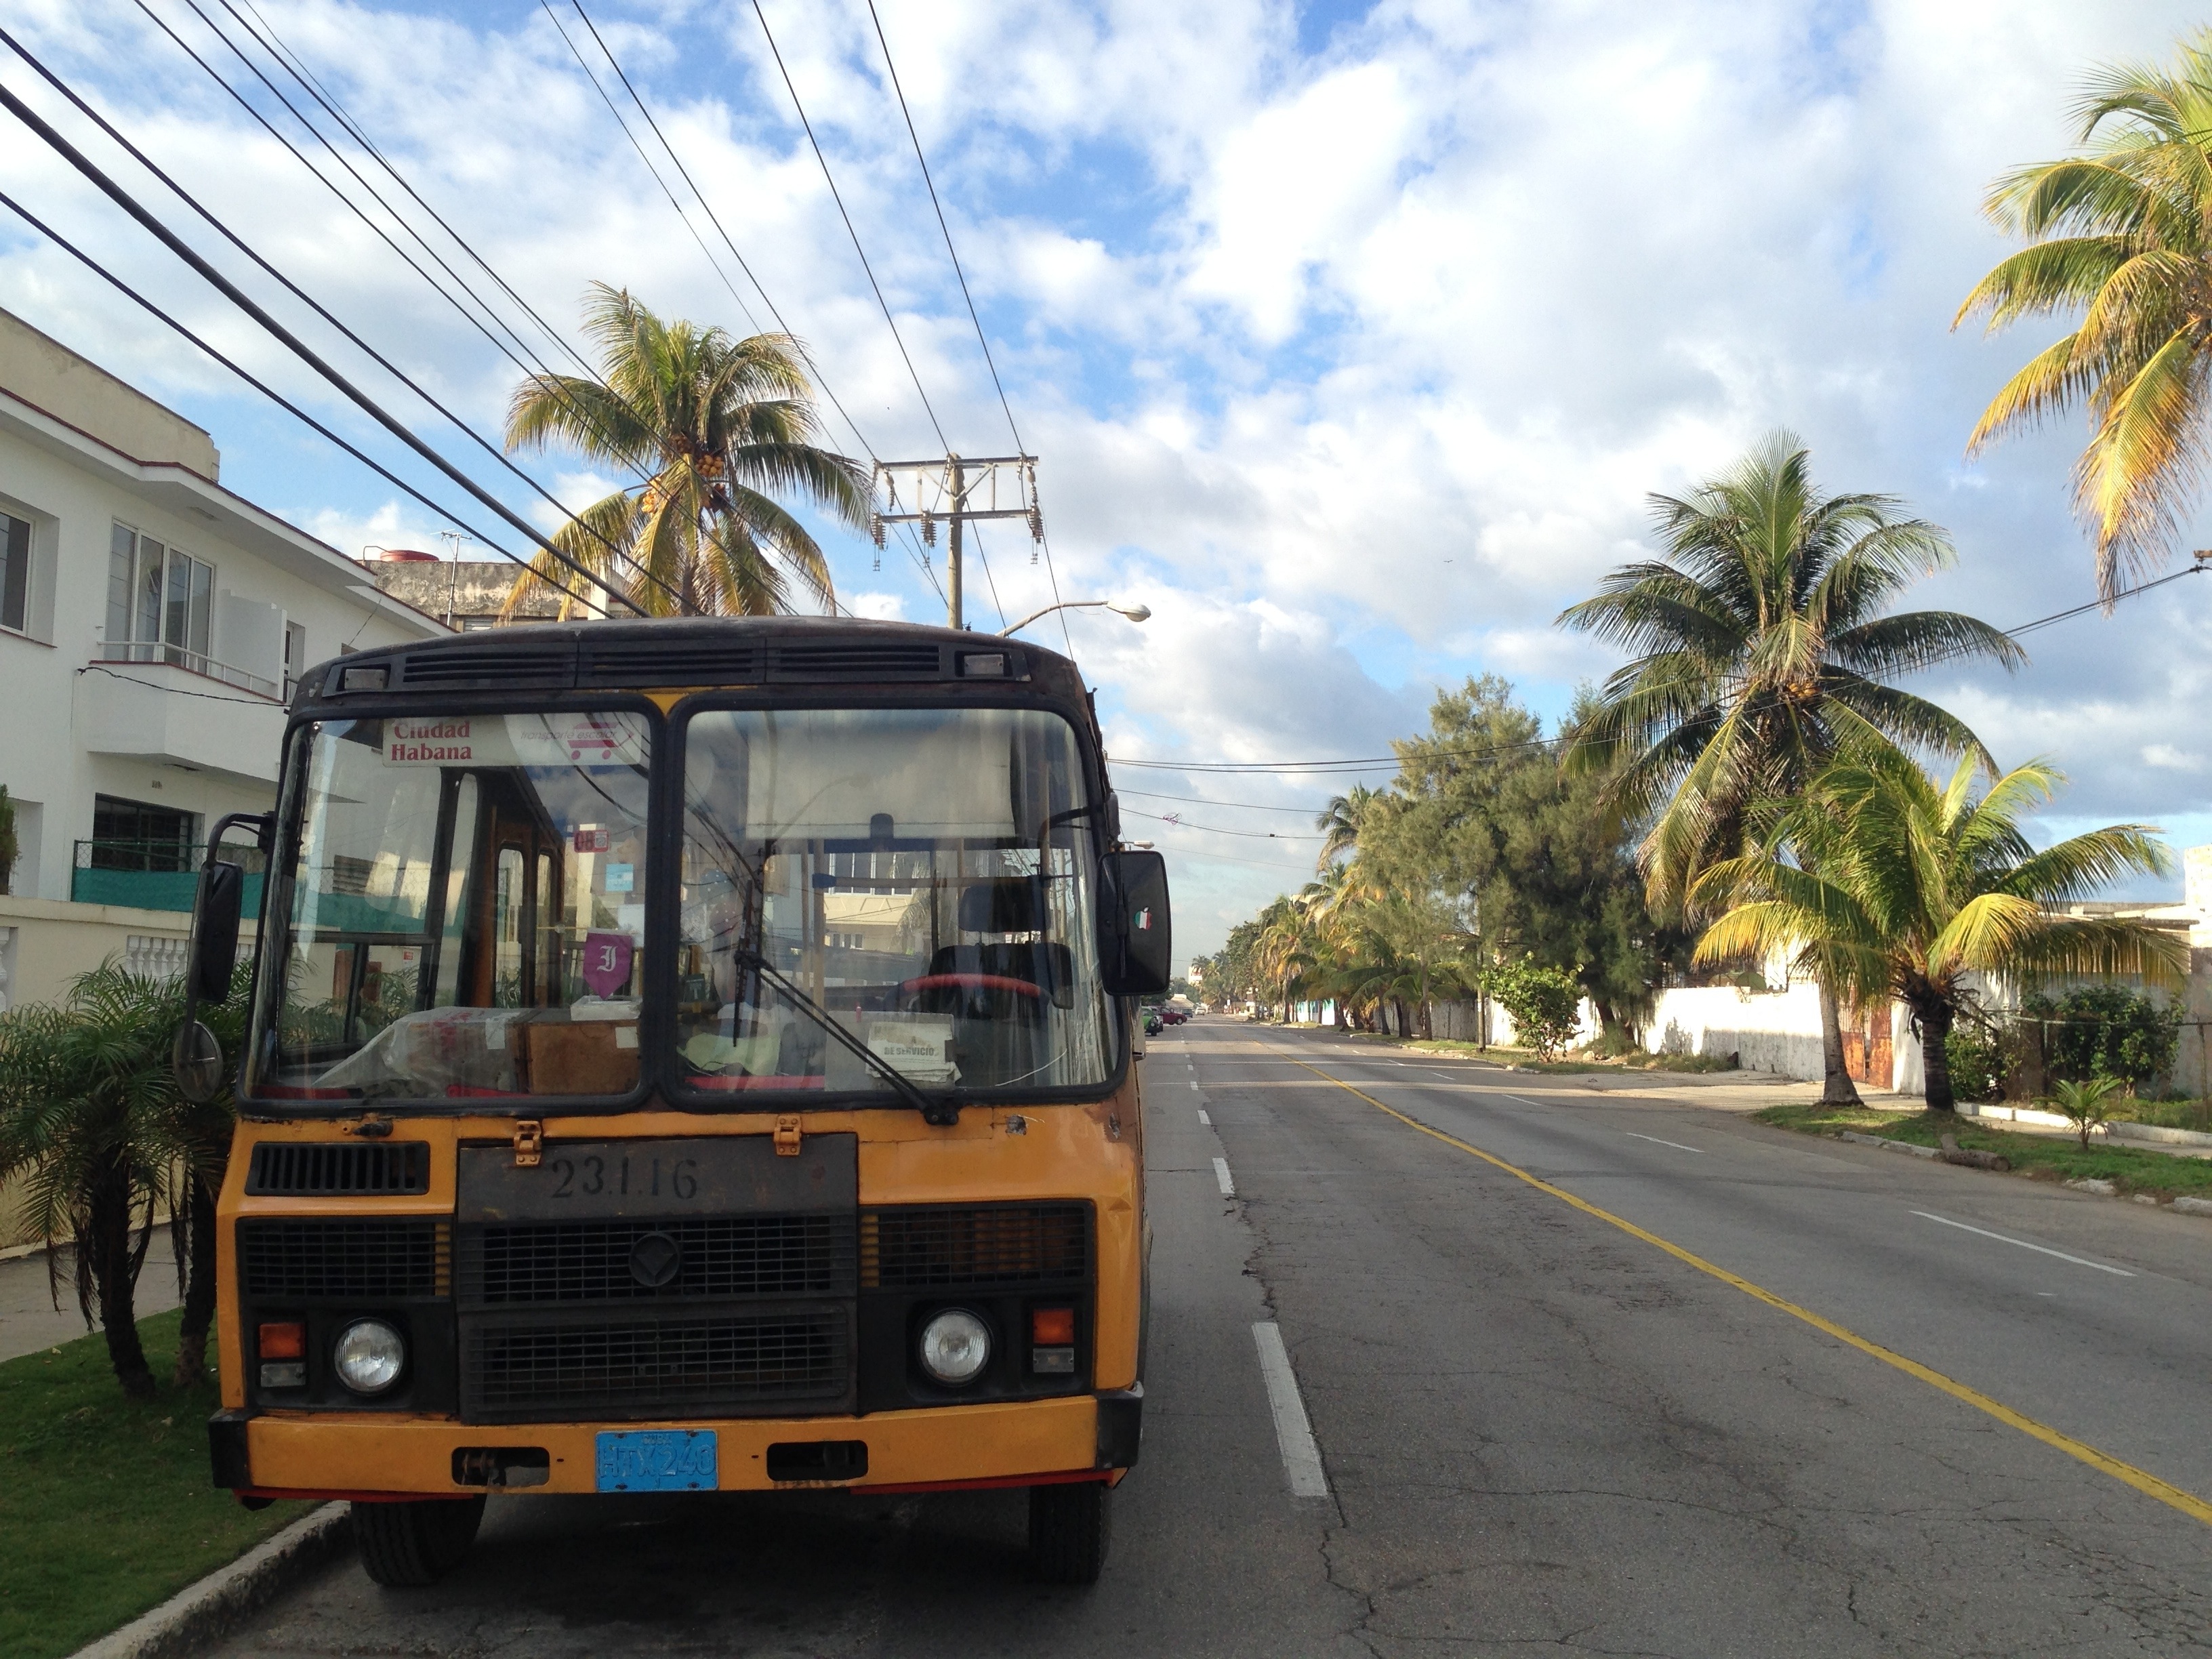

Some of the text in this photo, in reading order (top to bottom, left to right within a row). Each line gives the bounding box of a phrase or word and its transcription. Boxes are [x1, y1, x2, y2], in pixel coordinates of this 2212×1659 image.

[393, 720, 470, 739] Ciudad
[391, 743, 472, 761] Habana
[896, 1046, 935, 1056] SERVICIO
